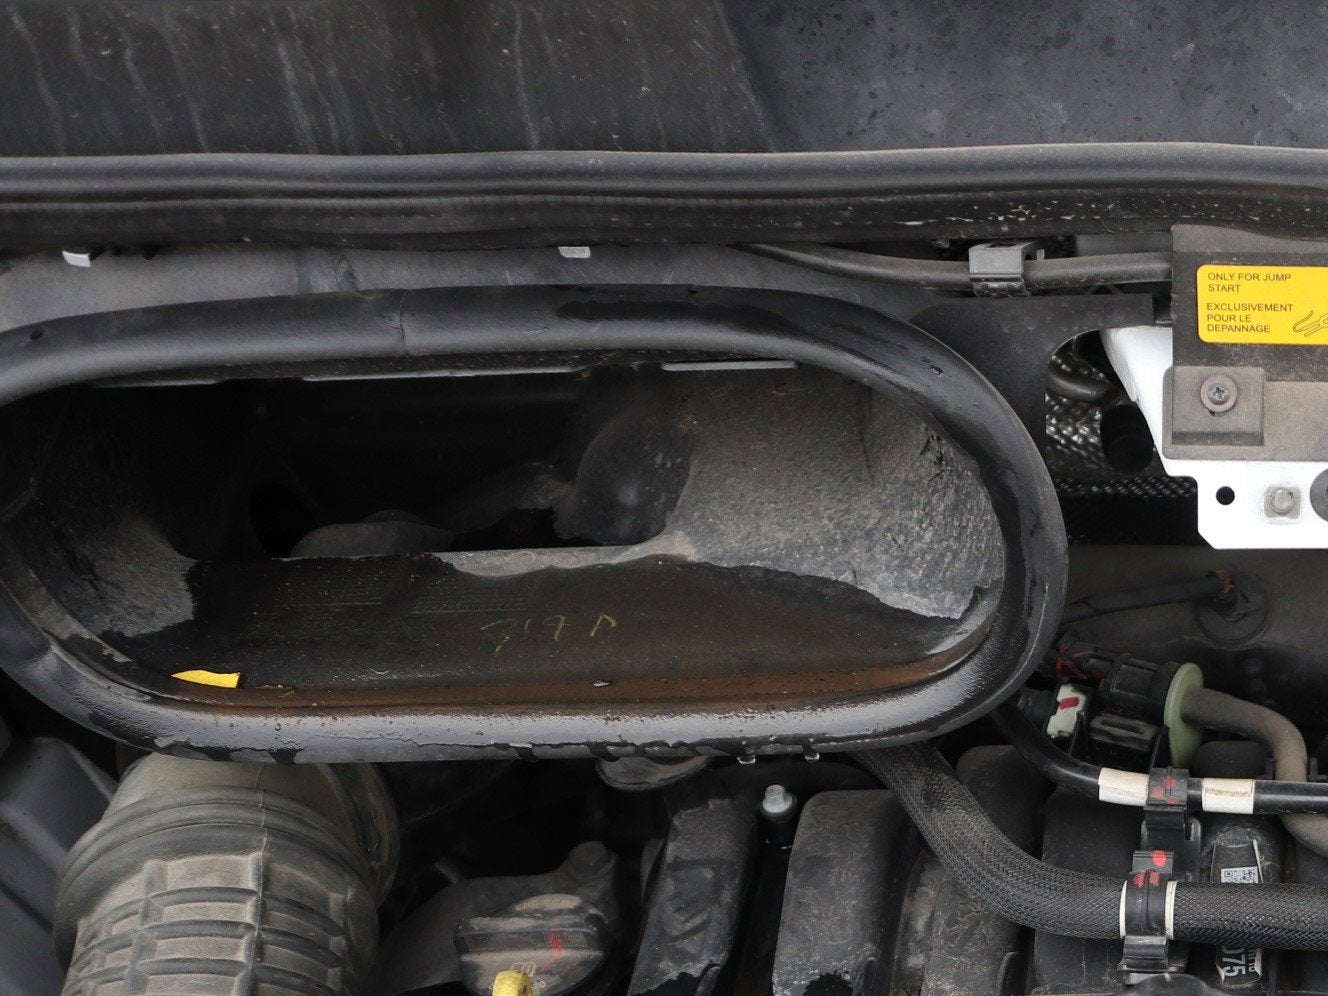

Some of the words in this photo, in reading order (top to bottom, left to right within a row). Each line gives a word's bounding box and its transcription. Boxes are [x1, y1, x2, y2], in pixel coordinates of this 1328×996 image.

[1207, 272, 1235, 281] ONLY
[1237, 272, 1260, 281] FOR
[1262, 273, 1292, 282] JUMP
[1208, 283, 1241, 293] START
[1206, 302, 1294, 312] EXCLUSIVEMENT
[1206, 314, 1237, 322] POUR
[1239, 314, 1252, 323] LE
[1207, 324, 1271, 333] DEPANNAGE
